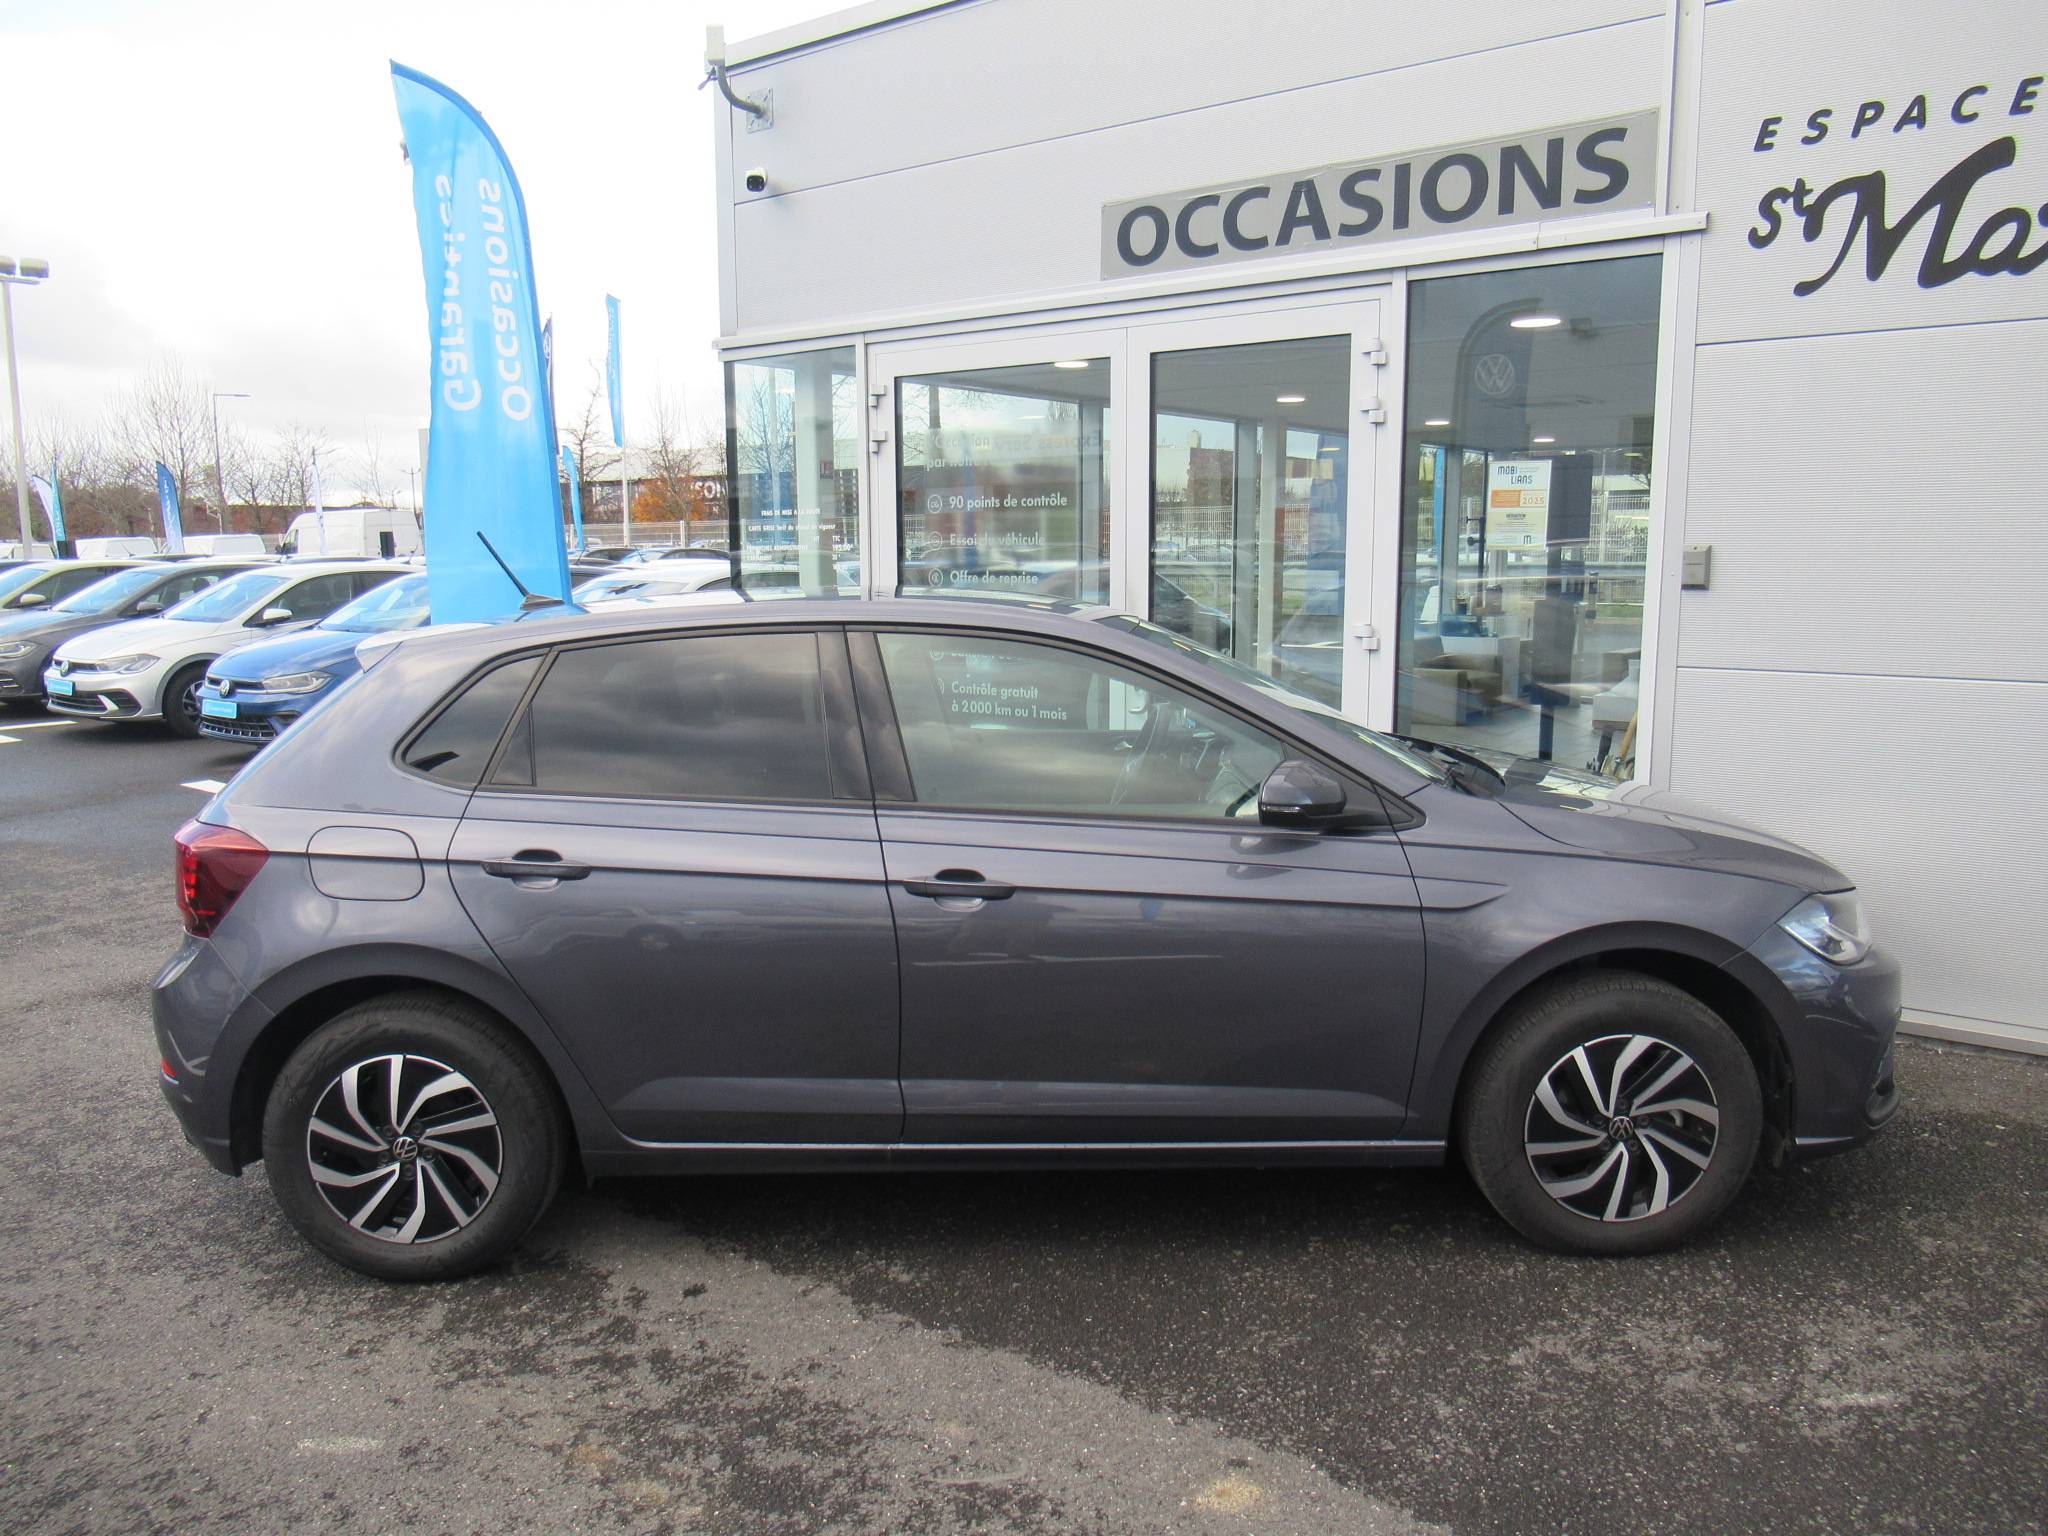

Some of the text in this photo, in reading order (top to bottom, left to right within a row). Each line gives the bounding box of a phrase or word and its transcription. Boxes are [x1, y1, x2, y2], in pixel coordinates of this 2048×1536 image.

[1753, 76, 2045, 152] ESPACE
[1116, 127, 1630, 267] OCCASIONS
[948, 492, 1068, 511] 90 points de contrôle
[950, 533, 977, 546] Essai
[950, 569, 1039, 587] Offre de reprise
[951, 681, 1039, 700] Contrôle gratuit
[951, 699, 959, 712] à
[994, 702, 1012, 716] km
[1014, 708, 1029, 718] ou
[1031, 704, 1037, 718] 1
[1039, 707, 1068, 720] mois
